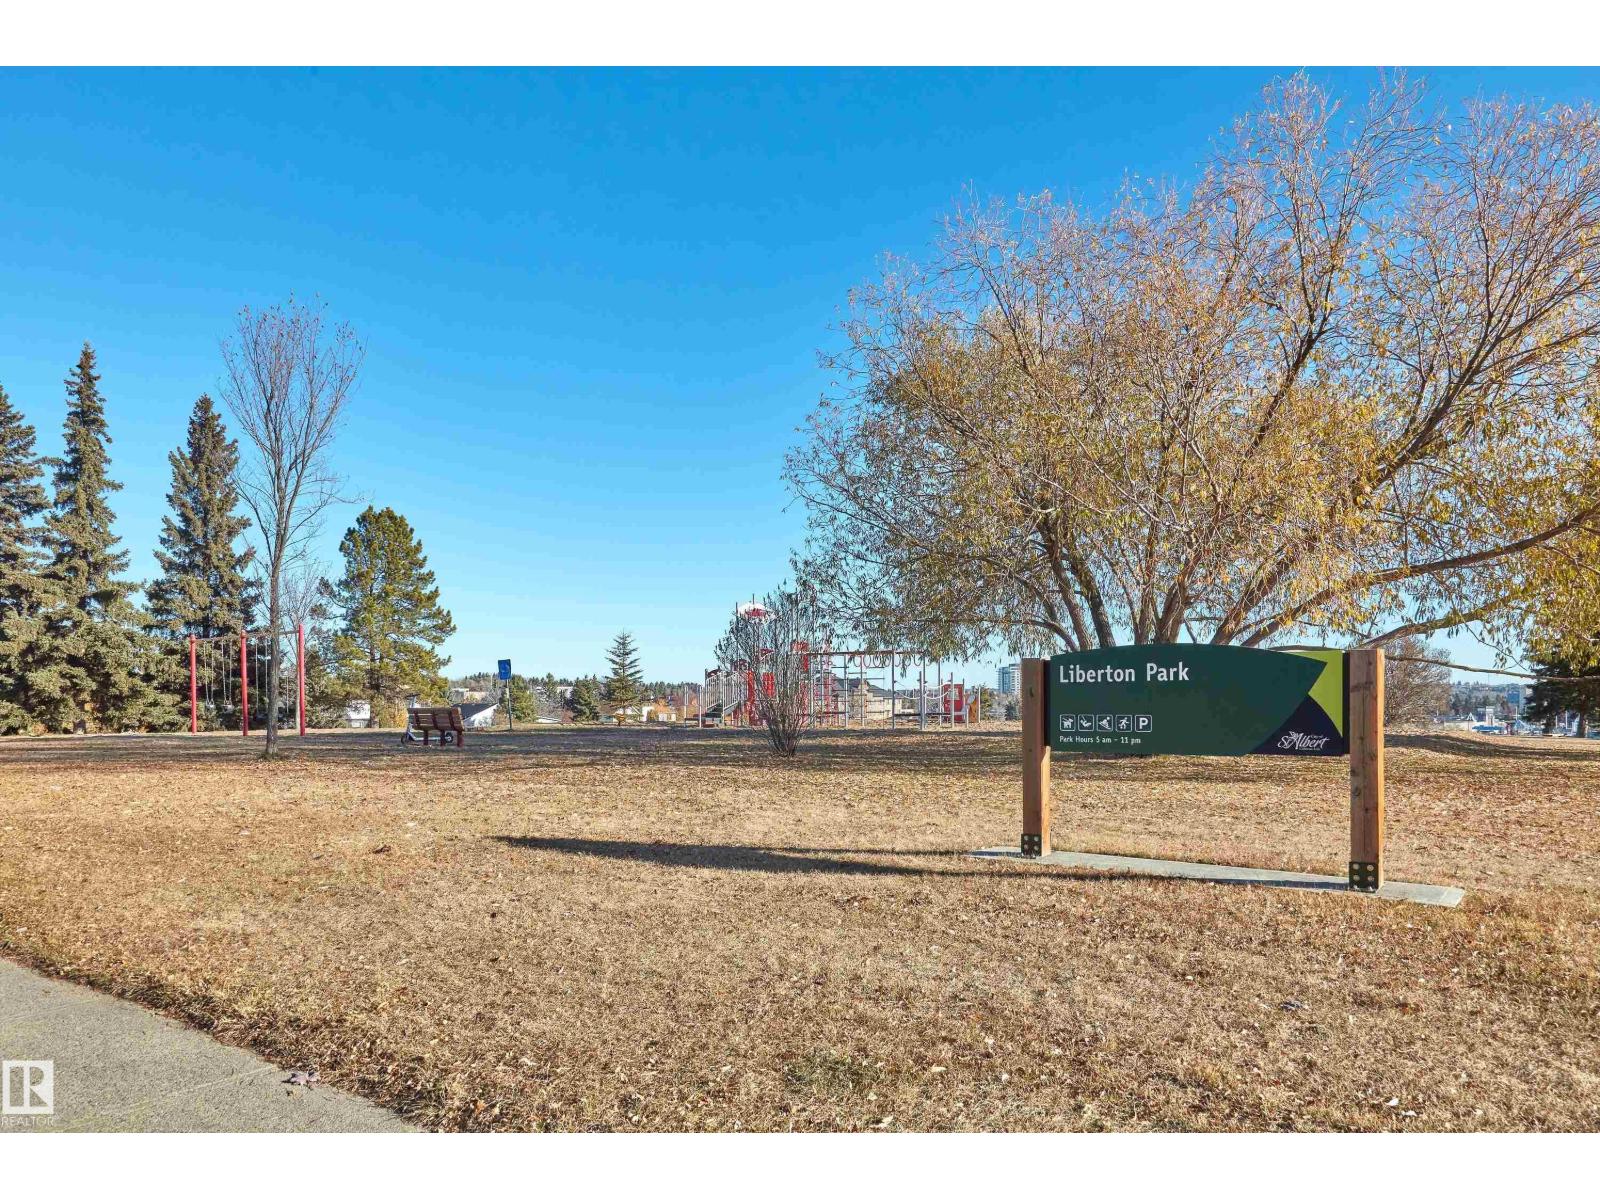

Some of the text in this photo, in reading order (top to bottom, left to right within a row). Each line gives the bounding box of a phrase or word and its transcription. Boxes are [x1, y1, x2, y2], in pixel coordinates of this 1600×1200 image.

[1059, 661, 1190, 683] Liberton Park
[1138, 717, 1149, 730] P
[1059, 735, 1074, 743] Park
[1075, 735, 1094, 744] Hours
[1095, 735, 1100, 743] 5
[1120, 736, 1129, 744] 11
[1131, 737, 1142, 746] pm
[1289, 731, 1330, 750] Albert
